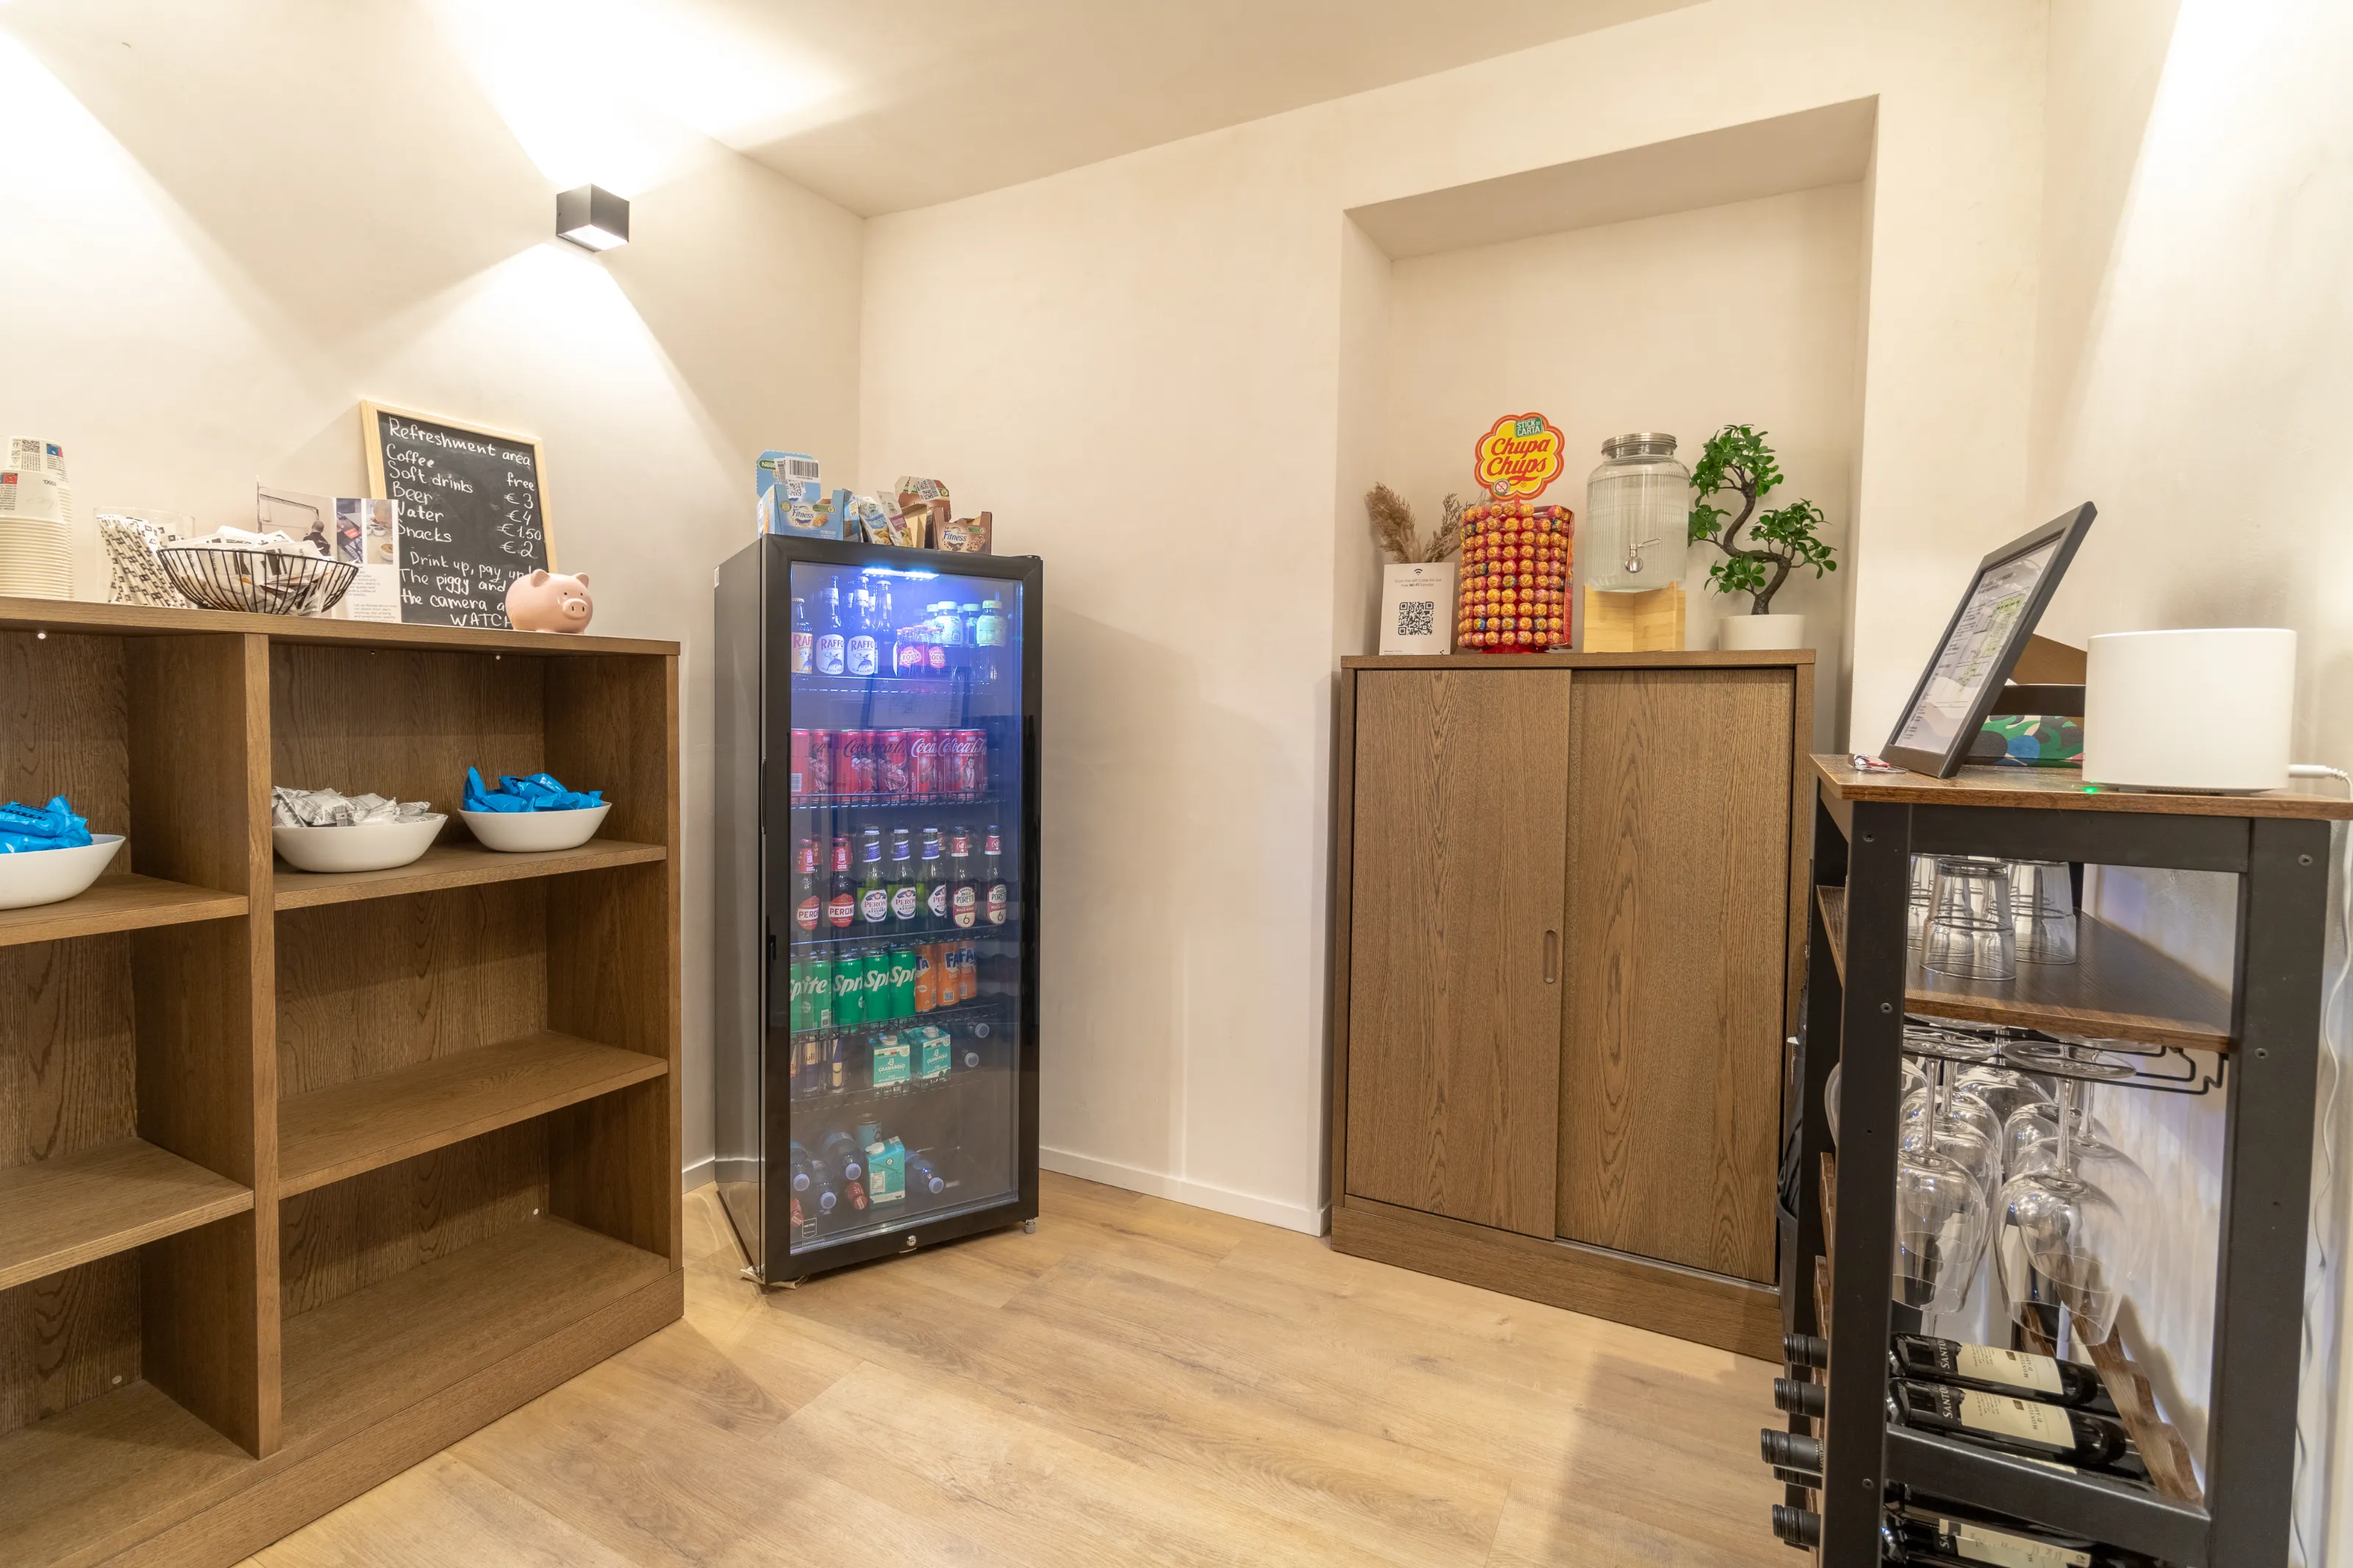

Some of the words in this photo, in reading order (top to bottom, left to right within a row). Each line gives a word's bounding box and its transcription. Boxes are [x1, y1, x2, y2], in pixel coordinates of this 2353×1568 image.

[1517, 420, 1535, 429] STICK
[1517, 426, 1540, 437] CARTA
[389, 416, 496, 457] Refreshment
[502, 451, 531, 467] area
[1491, 437, 1552, 459] Chupa
[386, 443, 435, 468] Coffee
[507, 472, 535, 492] free
[388, 460, 426, 484] Soft
[432, 473, 474, 494] drinks
[1487, 456, 1547, 486] Chups
[393, 481, 432, 505] Beer
[792, 509, 814, 519] Fitness
[399, 518, 452, 543] Snacks
[943, 530, 967, 542] Fitness
[410, 551, 449, 568] Drink
[454, 561, 474, 577] up,
[479, 564, 501, 583] pay
[399, 568, 429, 585] The
[436, 574, 469, 595] piggy
[479, 580, 507, 593] and
[401, 588, 424, 605] the
[430, 595, 488, 612] camera
[851, 640, 874, 651] RAFFO
[963, 914, 970, 925] 6
[997, 912, 1004, 921] 6
